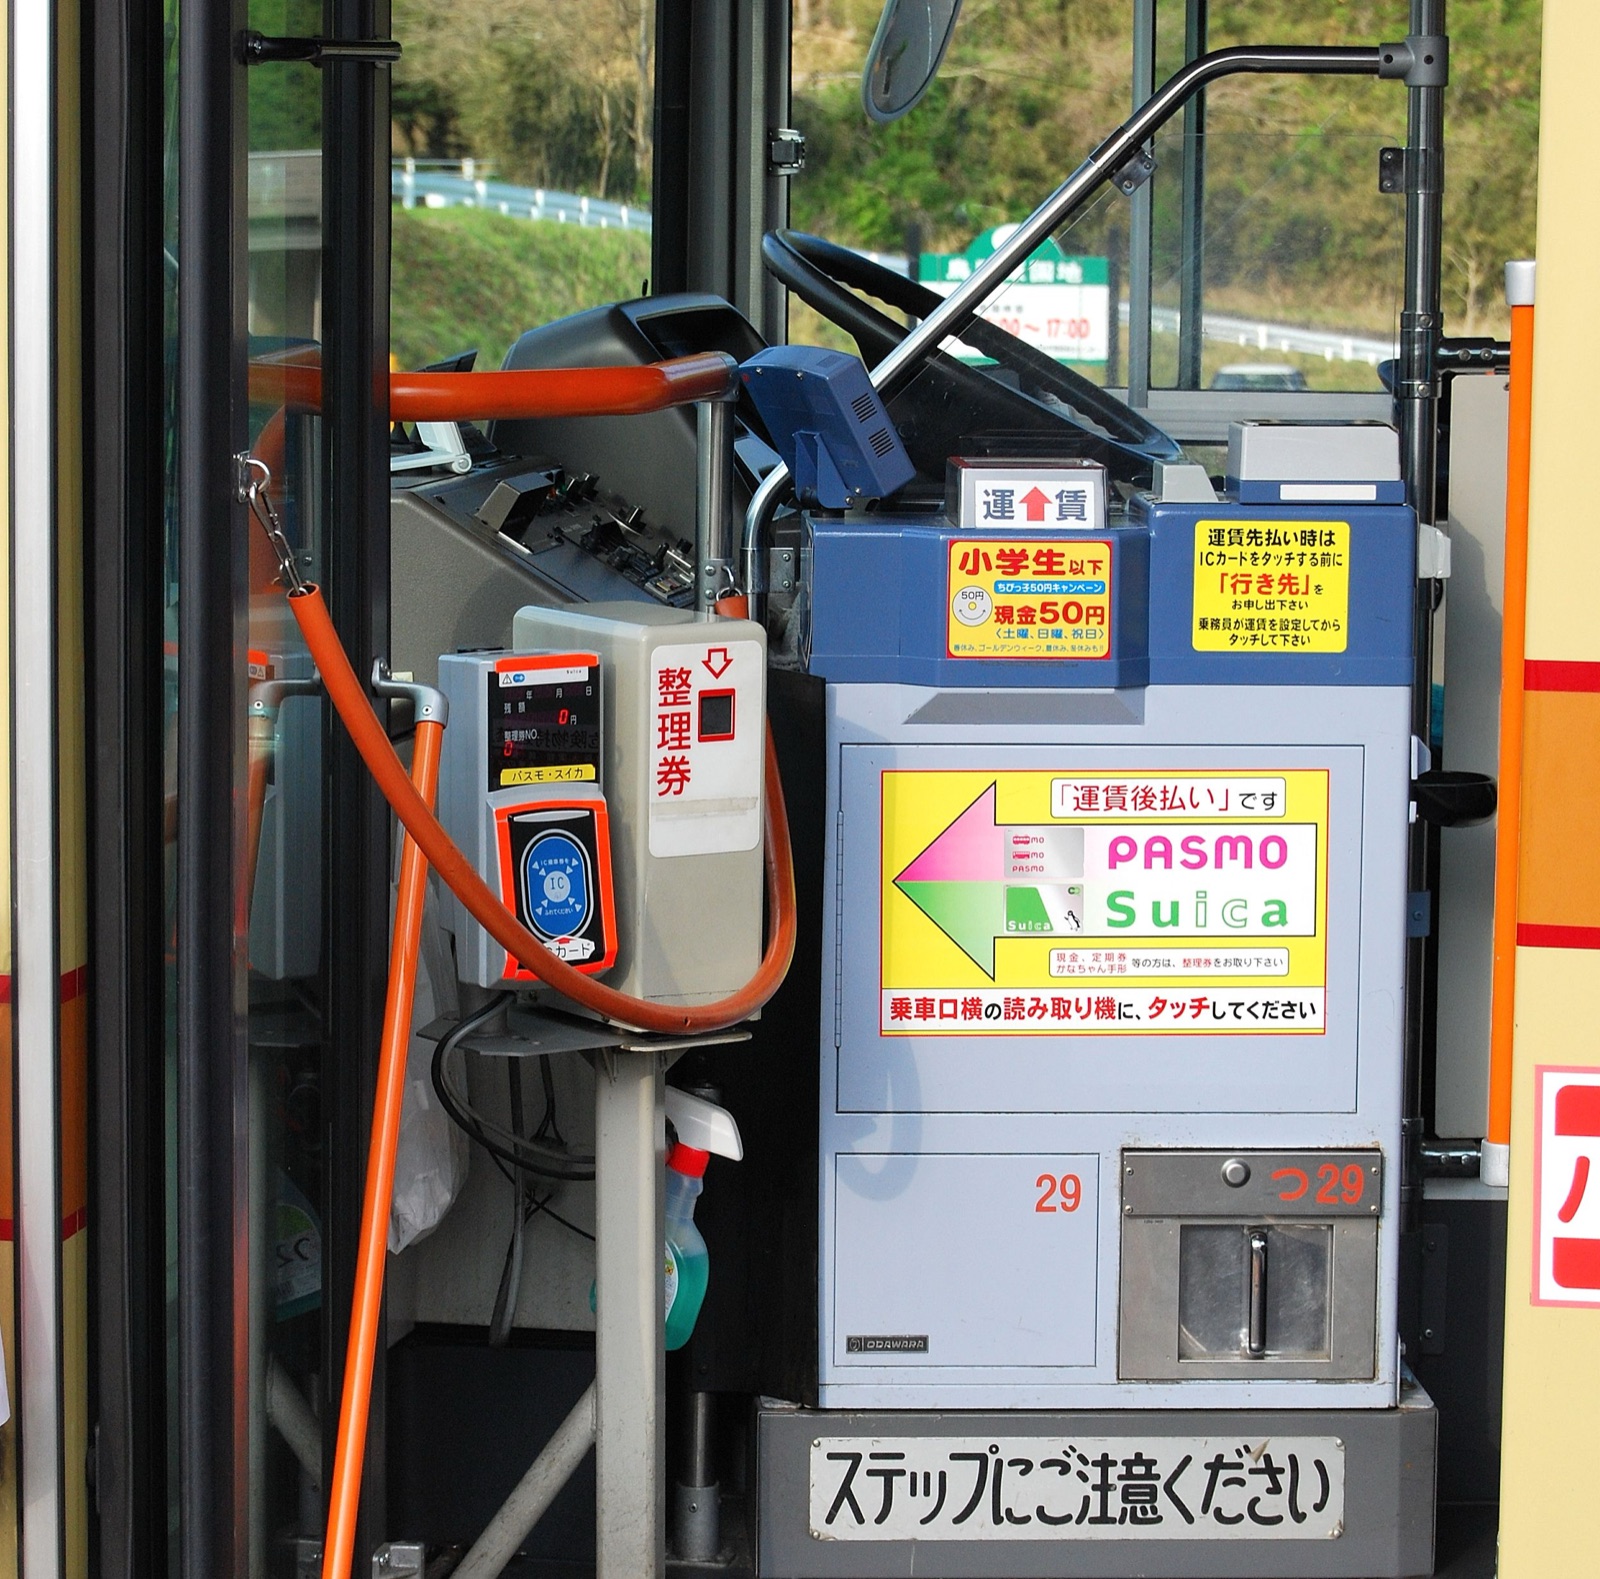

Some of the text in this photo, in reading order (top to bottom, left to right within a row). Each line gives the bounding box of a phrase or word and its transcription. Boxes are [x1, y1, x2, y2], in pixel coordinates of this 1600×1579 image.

[1208, 528, 1336, 547] 運賃先払い時は
[959, 548, 1103, 576] 小学生以下
[1199, 551, 1343, 567] ICカードをタッチする前に
[998, 583, 1102, 593] ちびっ子50円キャンペーン
[1219, 573, 1324, 596] 「行き先」を
[961, 591, 984, 600] 50円
[994, 601, 1105, 625] 現金50円
[1231, 599, 1309, 611] お申し出下さい
[1199, 618, 1341, 632] 乗務員が運賃を設定してから
[1229, 633, 1311, 646] タッチして下さい
[558, 708, 569, 725] 0
[657, 667, 692, 797] 整理券
[1060, 784, 1279, 813] 「運賃後払い」です
[1108, 835, 1288, 870] PASMO
[550, 876, 564, 890] IC
[1106, 890, 1289, 929] Suica
[1008, 921, 1051, 930] Suica
[547, 943, 590, 958] カード
[891, 996, 1316, 1022] 乗車口横の読み取り機に、タッチしてください
[1035, 1173, 1082, 1213] 29
[867, 1341, 924, 1349] ODAWARA
[825, 1444, 1330, 1525] ステップにご注意ください
